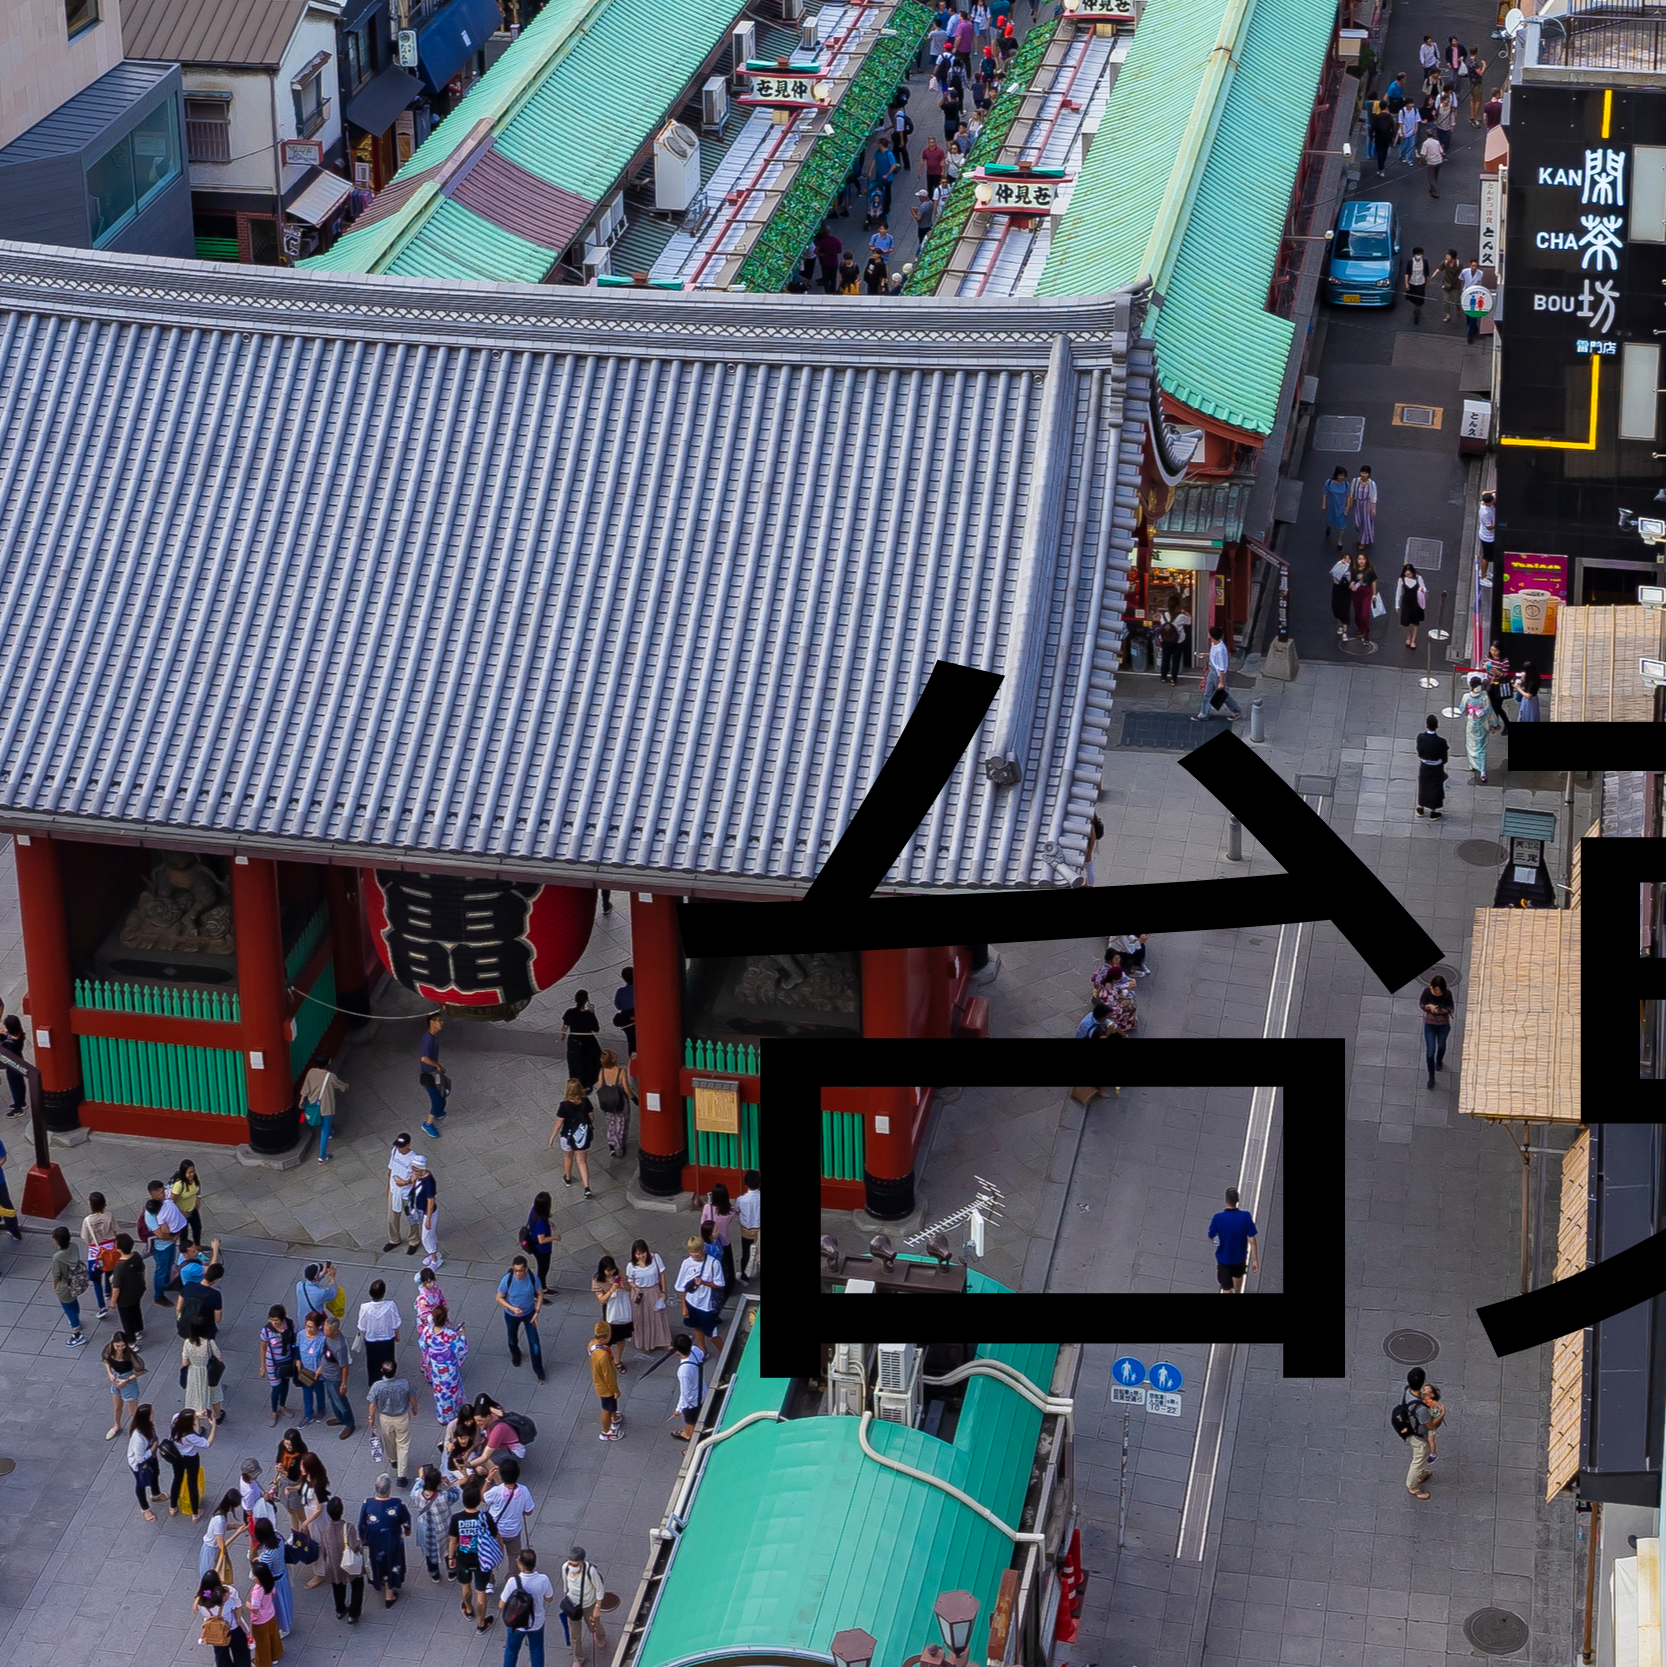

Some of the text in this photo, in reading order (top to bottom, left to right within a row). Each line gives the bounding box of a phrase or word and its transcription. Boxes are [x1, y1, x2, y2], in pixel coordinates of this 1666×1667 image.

[1538, 167, 1583, 188] KAN
[1481, 226, 1495, 265] とん久
[1535, 231, 1579, 251] CHA
[1533, 294, 1575, 313] BOU
[1576, 339, 1617, 356] 雷門店
